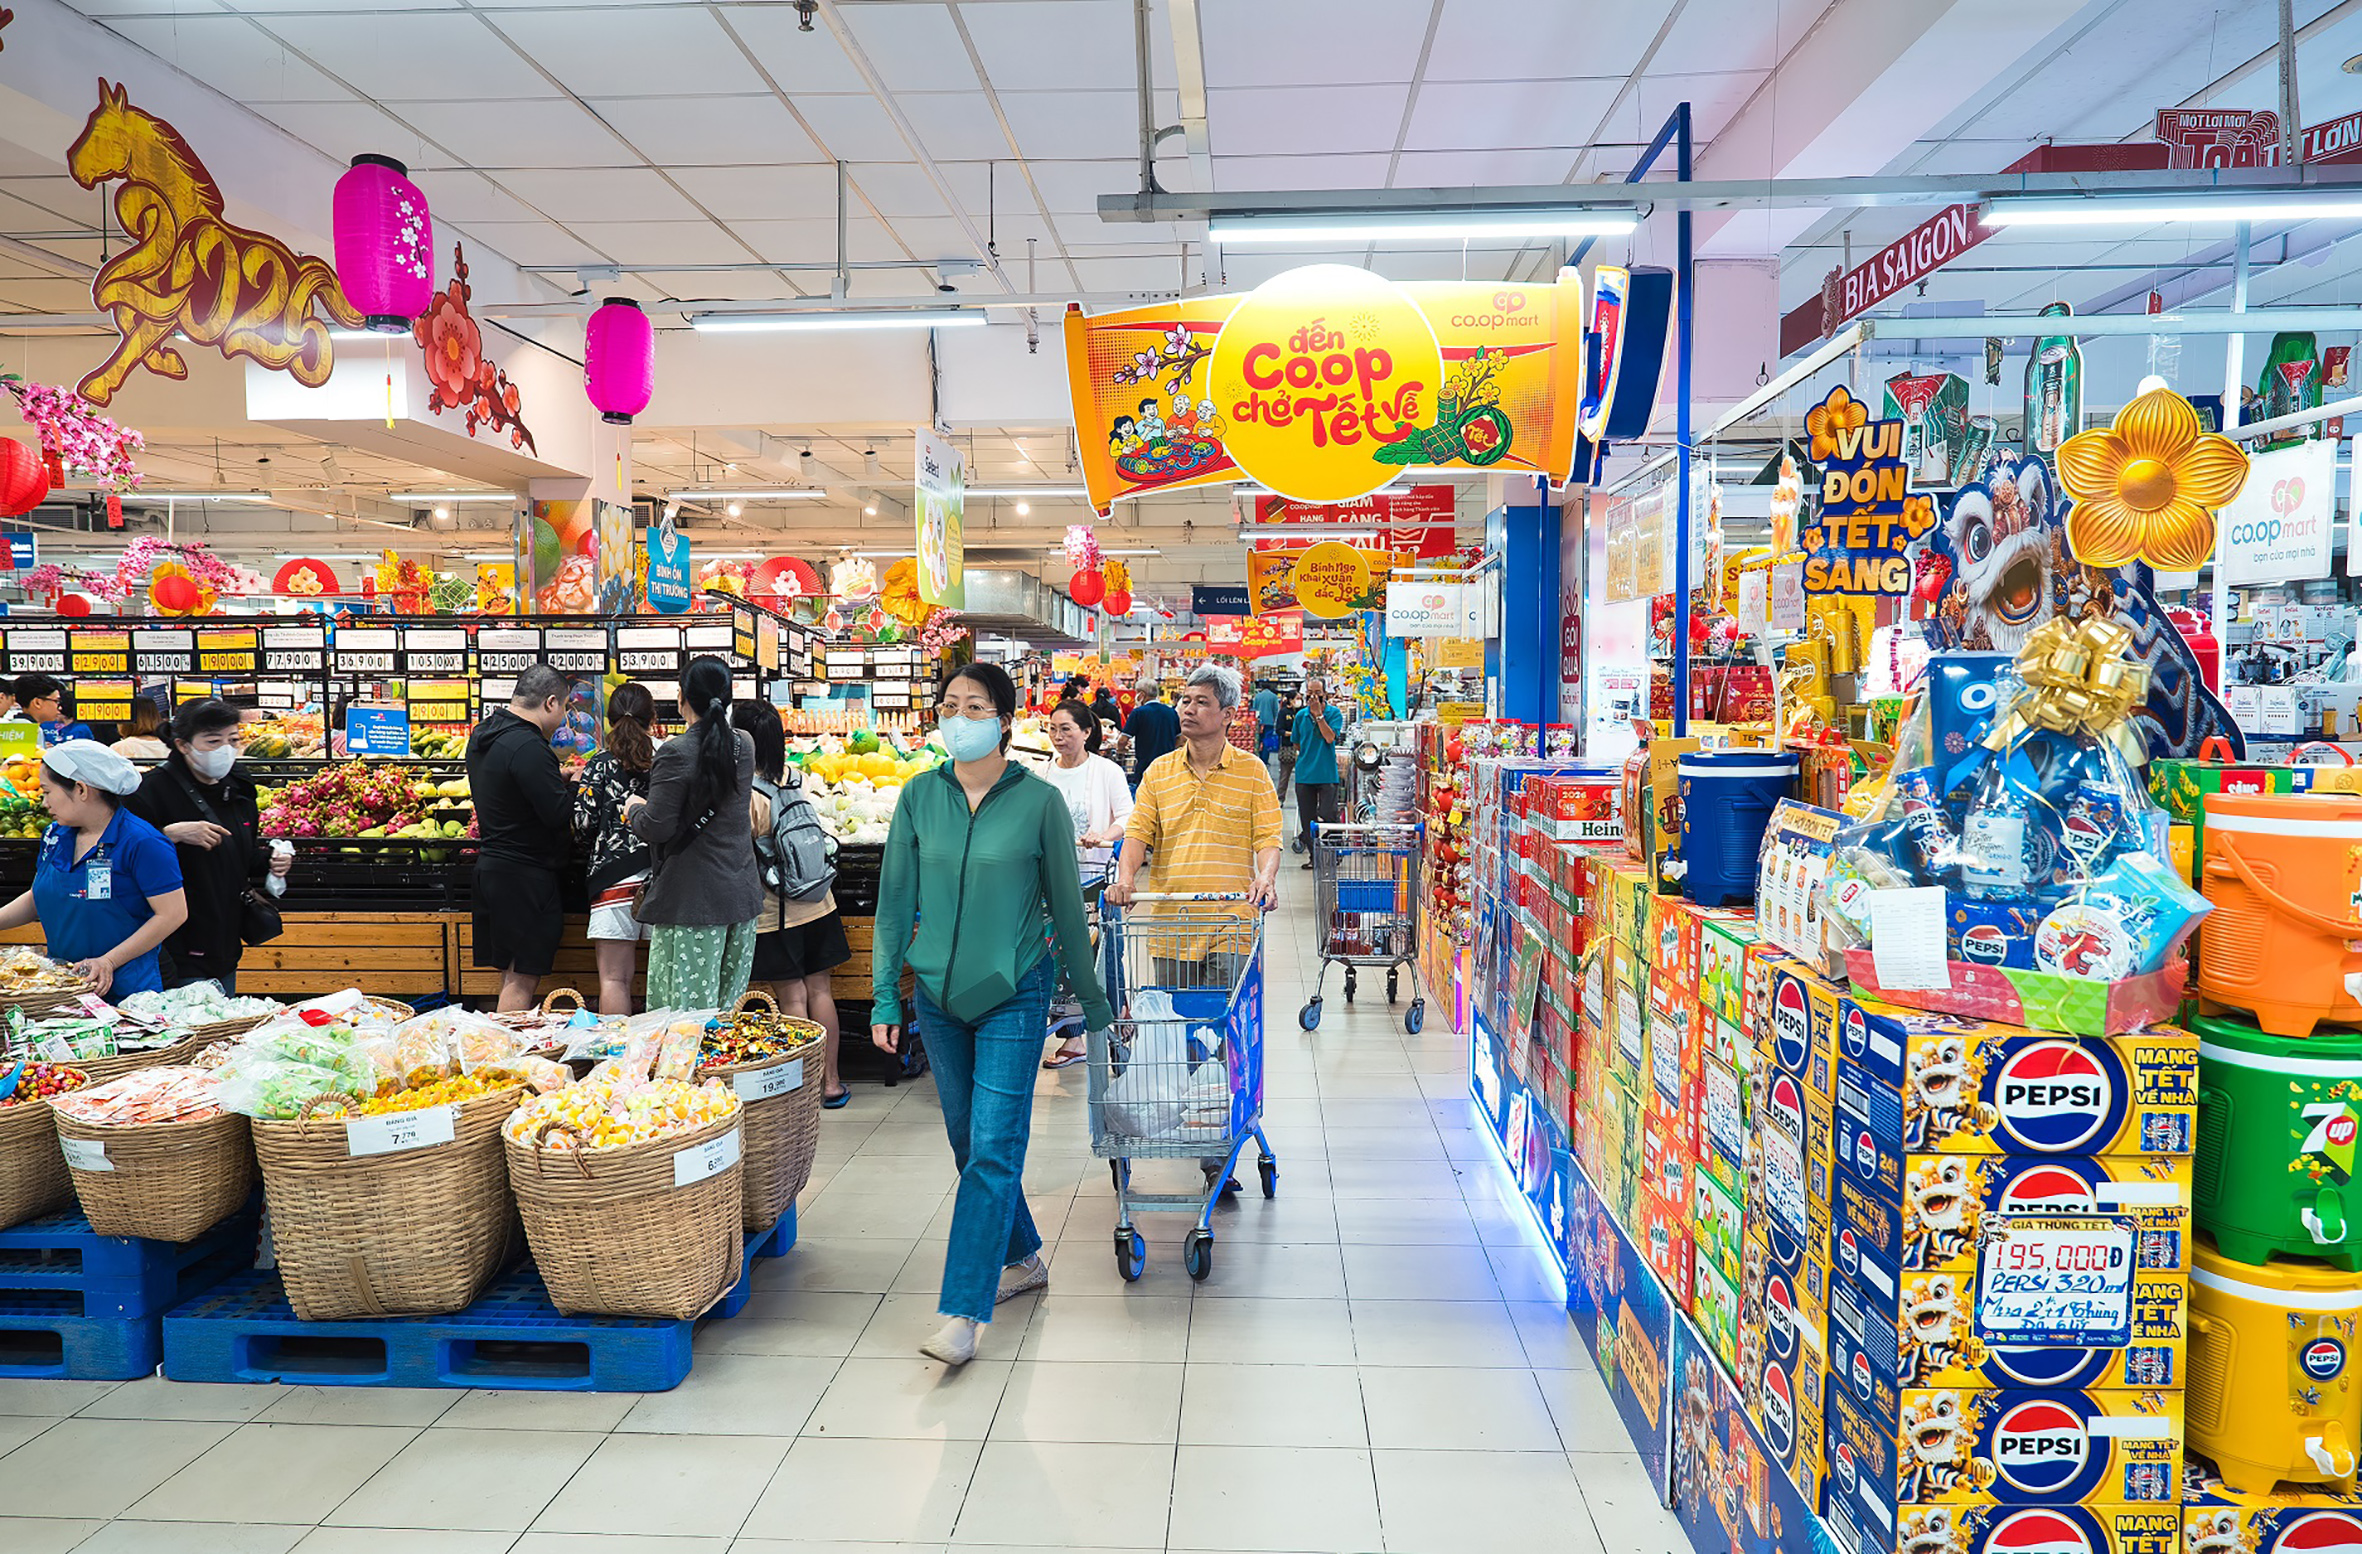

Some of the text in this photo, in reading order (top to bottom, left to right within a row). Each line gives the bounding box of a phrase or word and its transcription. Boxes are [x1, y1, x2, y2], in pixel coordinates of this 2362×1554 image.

[2312, 116, 2362, 156] LỚN
[1844, 203, 1967, 317] BIA SAIGON
[94, 181, 335, 388] 2026
[1289, 317, 1346, 354] đến
[1243, 342, 1393, 401] Co.op
[1233, 390, 1293, 428] chở
[1293, 393, 1413, 448] Tết
[1467, 424, 1495, 448] Tết
[1836, 423, 1902, 460] VUI
[1823, 461, 1906, 504] ĐÓN
[1822, 504, 1899, 549] TẾT
[2231, 515, 2317, 546] co.opmart
[1300, 573, 1322, 583] Khai
[1804, 557, 1910, 592] SANG
[1391, 609, 1454, 623] co.opmart
[11, 656, 54, 669] 39.900
[138, 655, 180, 668] 61.500
[266, 653, 312, 666] 77.900
[339, 655, 383, 668] 36.900
[621, 655, 667, 667] 53.900
[1562, 790, 1587, 799] 2026
[1965, 938, 2004, 955] PEPSI
[1777, 1006, 1805, 1041] PEPSI
[1847, 1021, 1865, 1041] PEPSI
[2134, 1048, 2199, 1066] MANG
[2141, 1064, 2192, 1089] TẾT
[2005, 1084, 2101, 1108] PEPSI
[2135, 1089, 2198, 1106] VỀ NHÀ
[1773, 1103, 1800, 1141] PEPSI
[1858, 1145, 1874, 1164] PEPSI
[2131, 1204, 2190, 1217] MANG TẾT
[1841, 1243, 1858, 1263] PEPSI
[2136, 1282, 2183, 1300] ANG
[1768, 1298, 1792, 1337] PEPSI
[1625, 1316, 1637, 1353] VUI
[2146, 1321, 2181, 1338] NHÀ
[2309, 1354, 2338, 1362] PEPSI
[1853, 1364, 1871, 1387] PEPSI
[1635, 1365, 1656, 1420] SANG
[1765, 1385, 1791, 1434] PEPSI
[2000, 1437, 2082, 1456] PEPSI
[2122, 1438, 2180, 1450] MANG TẾT
[2129, 1450, 2171, 1461] VỀ NHÀ
[1837, 1457, 1855, 1481] PEPSI
[2115, 1515, 2177, 1532] MANG
[2119, 1529, 2172, 1554] TẾT
